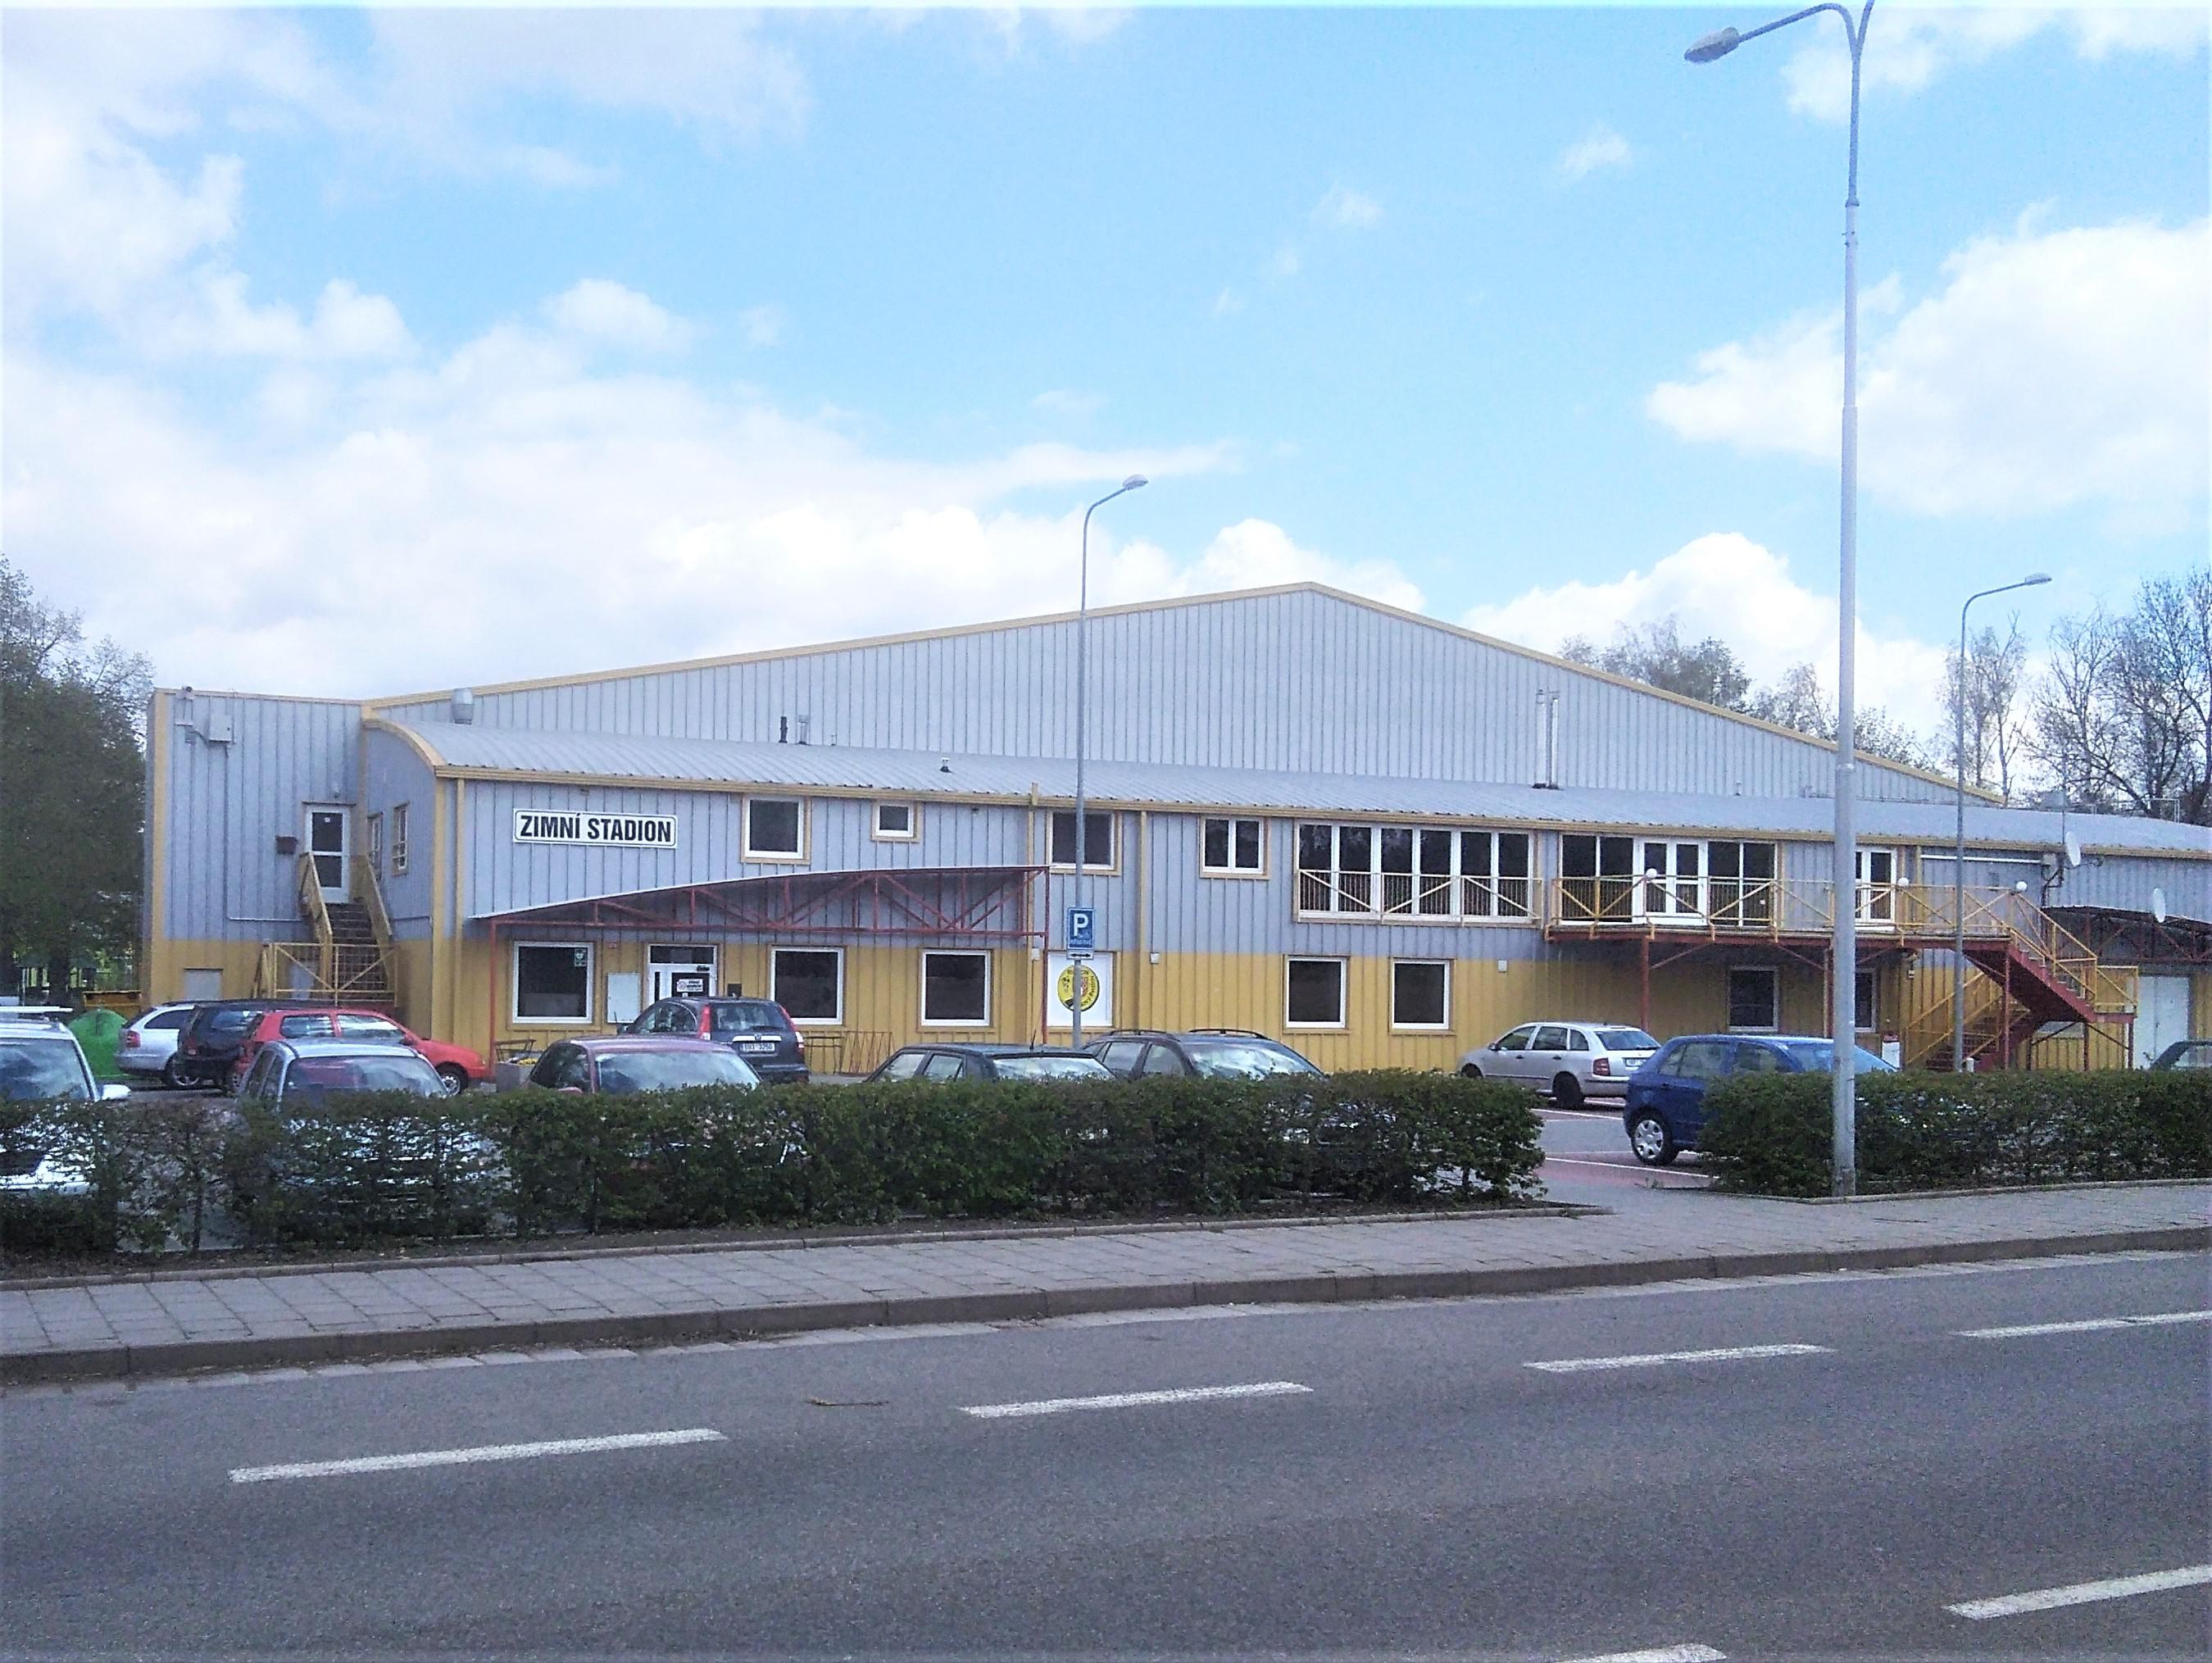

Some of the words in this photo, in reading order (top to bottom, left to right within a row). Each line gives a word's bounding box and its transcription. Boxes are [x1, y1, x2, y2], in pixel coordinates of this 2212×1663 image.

[520, 813, 580, 838] ZIMNÍ
[587, 818, 671, 843] STADION
[1074, 914, 1088, 937] P
